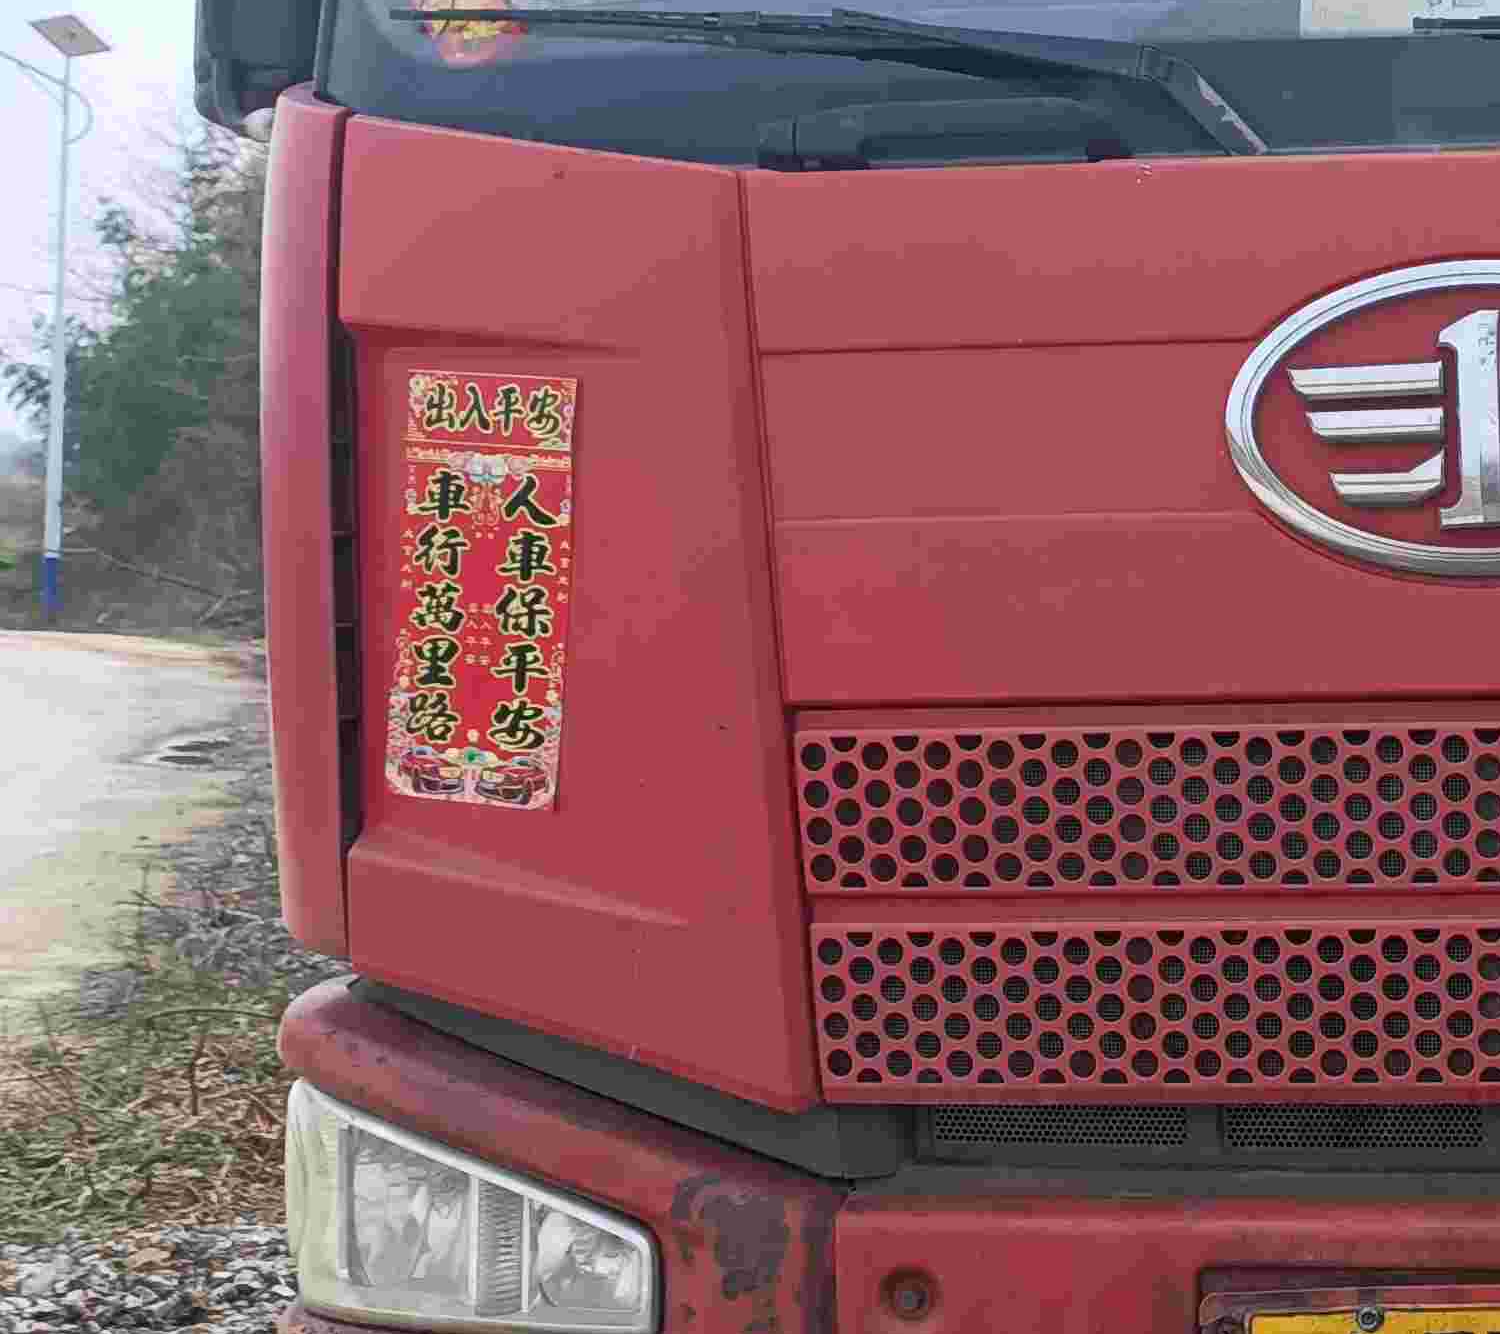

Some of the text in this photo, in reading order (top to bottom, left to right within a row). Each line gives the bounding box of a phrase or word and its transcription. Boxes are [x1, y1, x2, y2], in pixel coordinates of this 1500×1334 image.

[424, 382, 561, 438] 出入平安
[405, 468, 472, 744] 車行萬里路
[488, 475, 559, 750] 人車保平安
